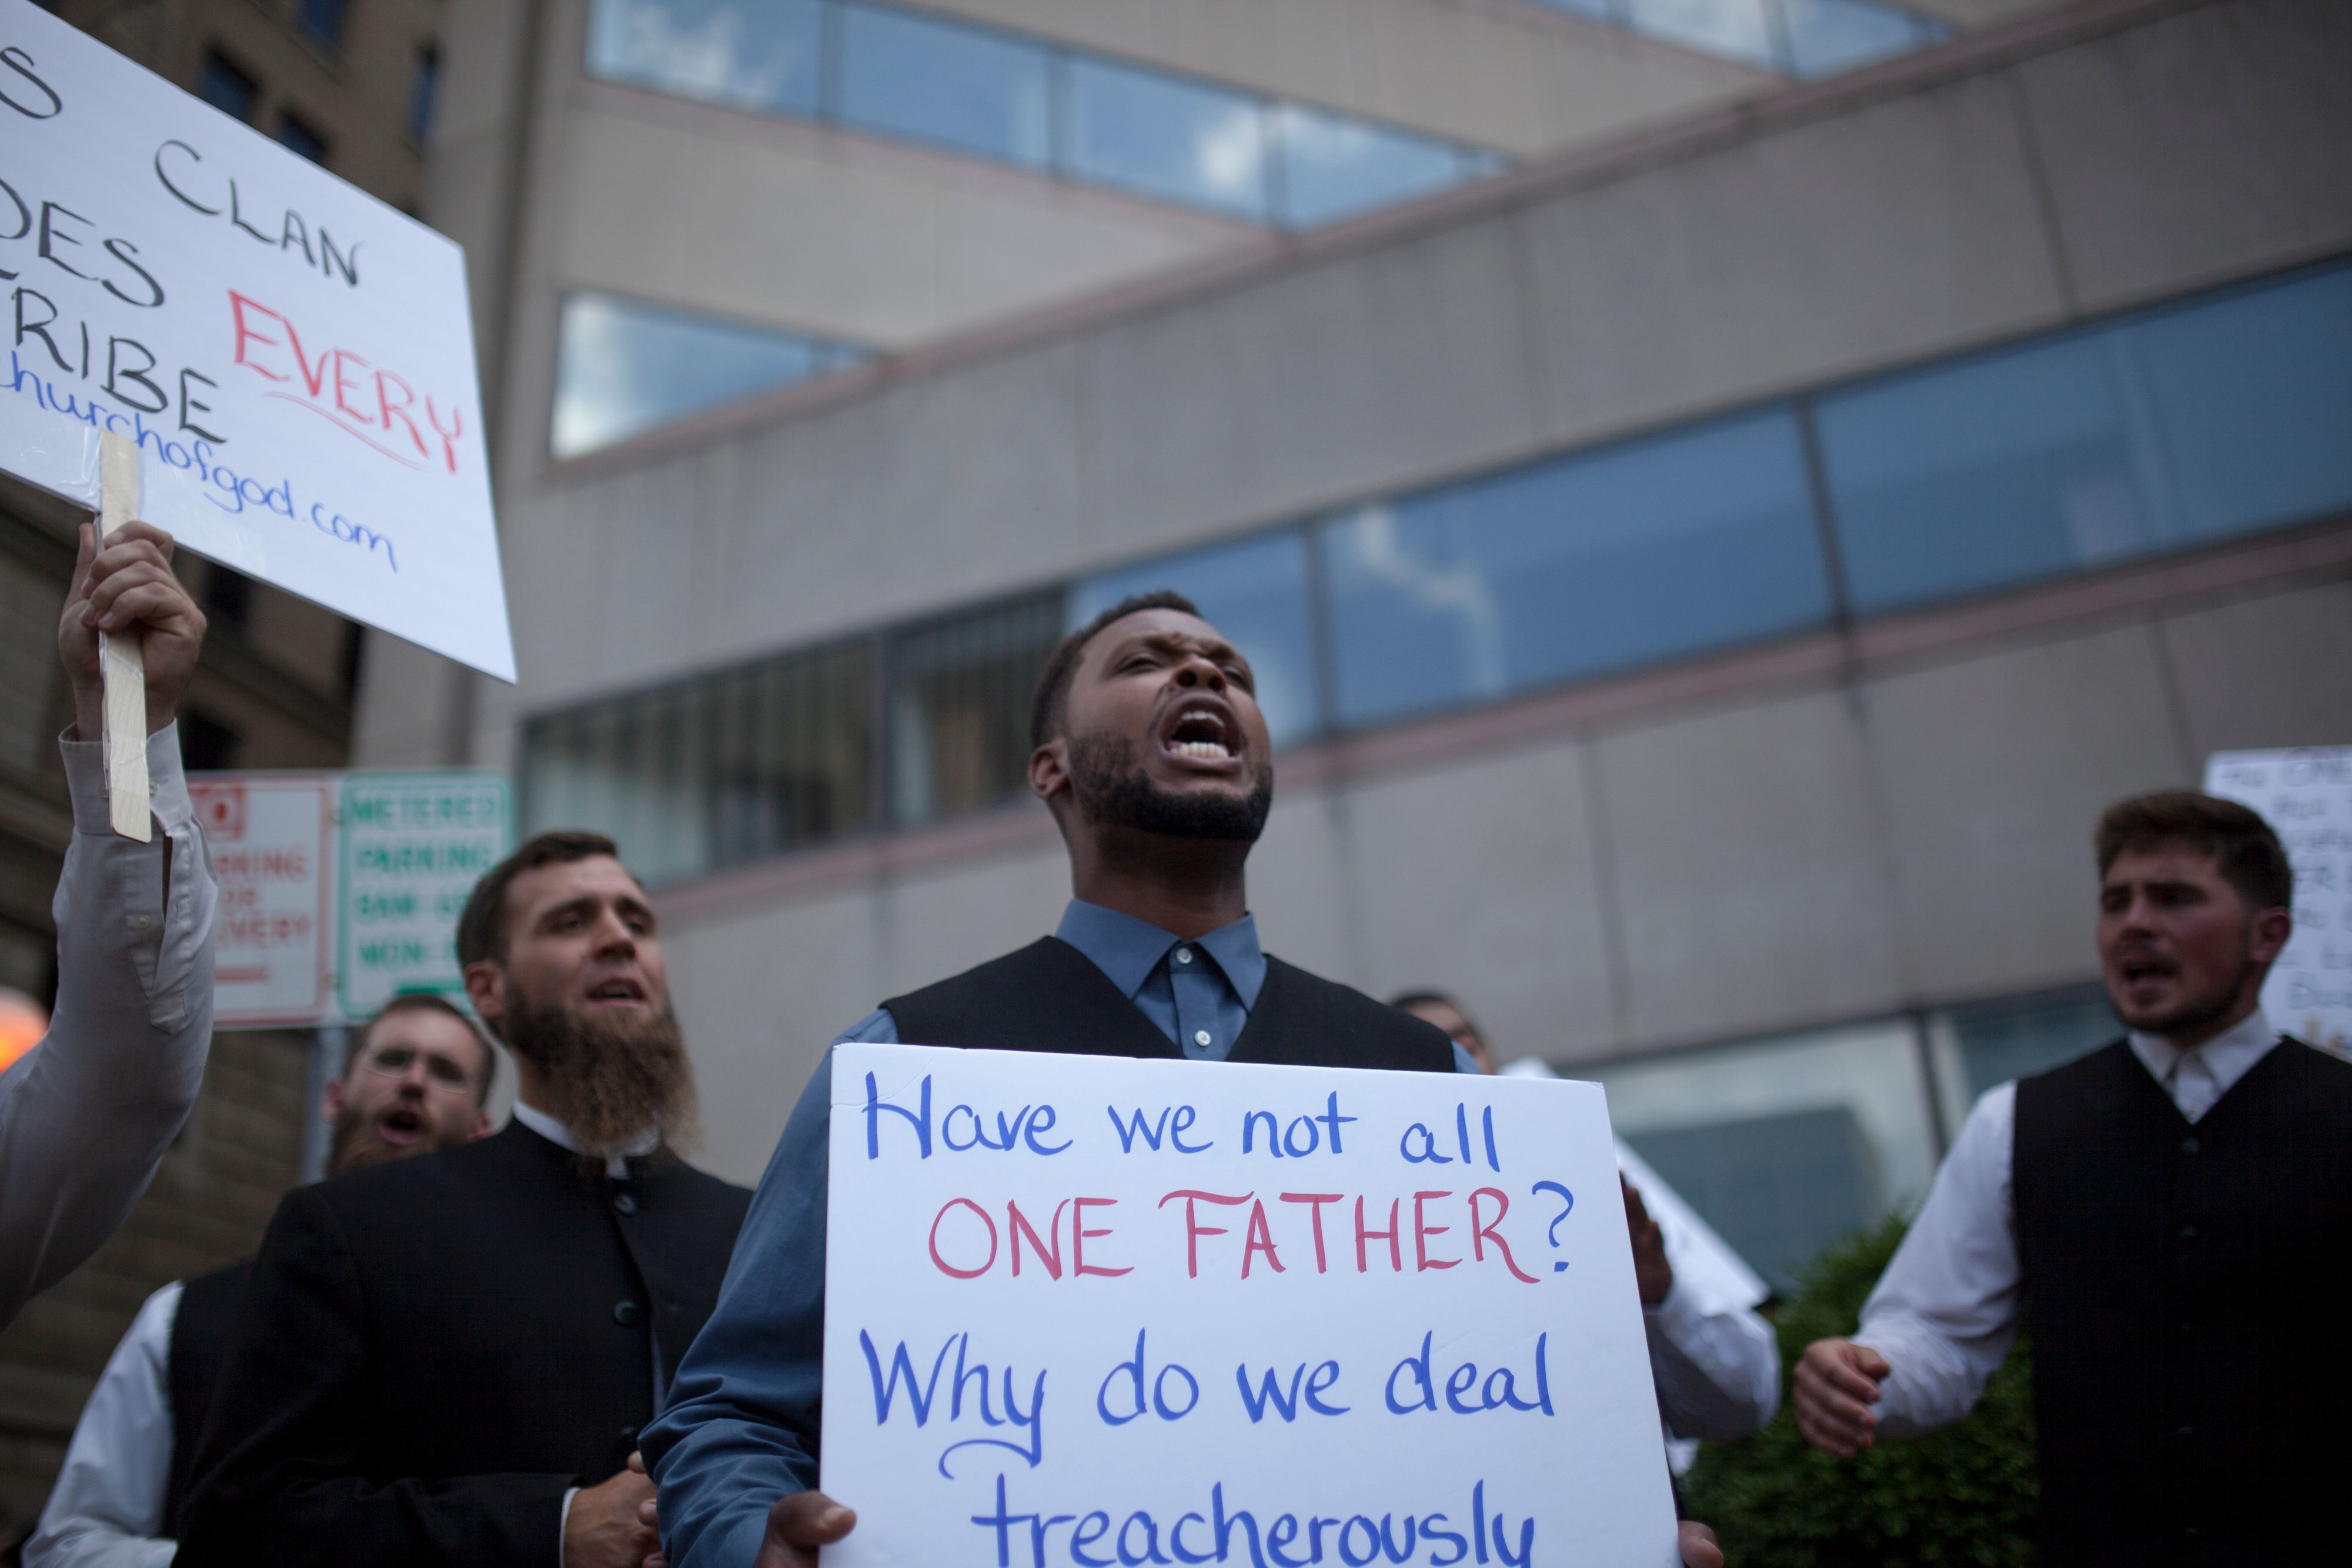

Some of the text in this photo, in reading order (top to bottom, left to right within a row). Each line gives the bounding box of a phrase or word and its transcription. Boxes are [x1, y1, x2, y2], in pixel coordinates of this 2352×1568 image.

[154, 139, 365, 288] CLAN
[0, 269, 228, 444] RIBE
[228, 287, 463, 474] EVERY
[351, 795, 496, 824] METERED
[356, 844, 492, 872] PARKING
[861, 1071, 1501, 1174] Have we not all
[928, 1180, 1575, 1285] ONE FATHER?
[858, 1328, 1555, 1480] Why do we deal
[970, 1473, 1535, 1568] treacherously
